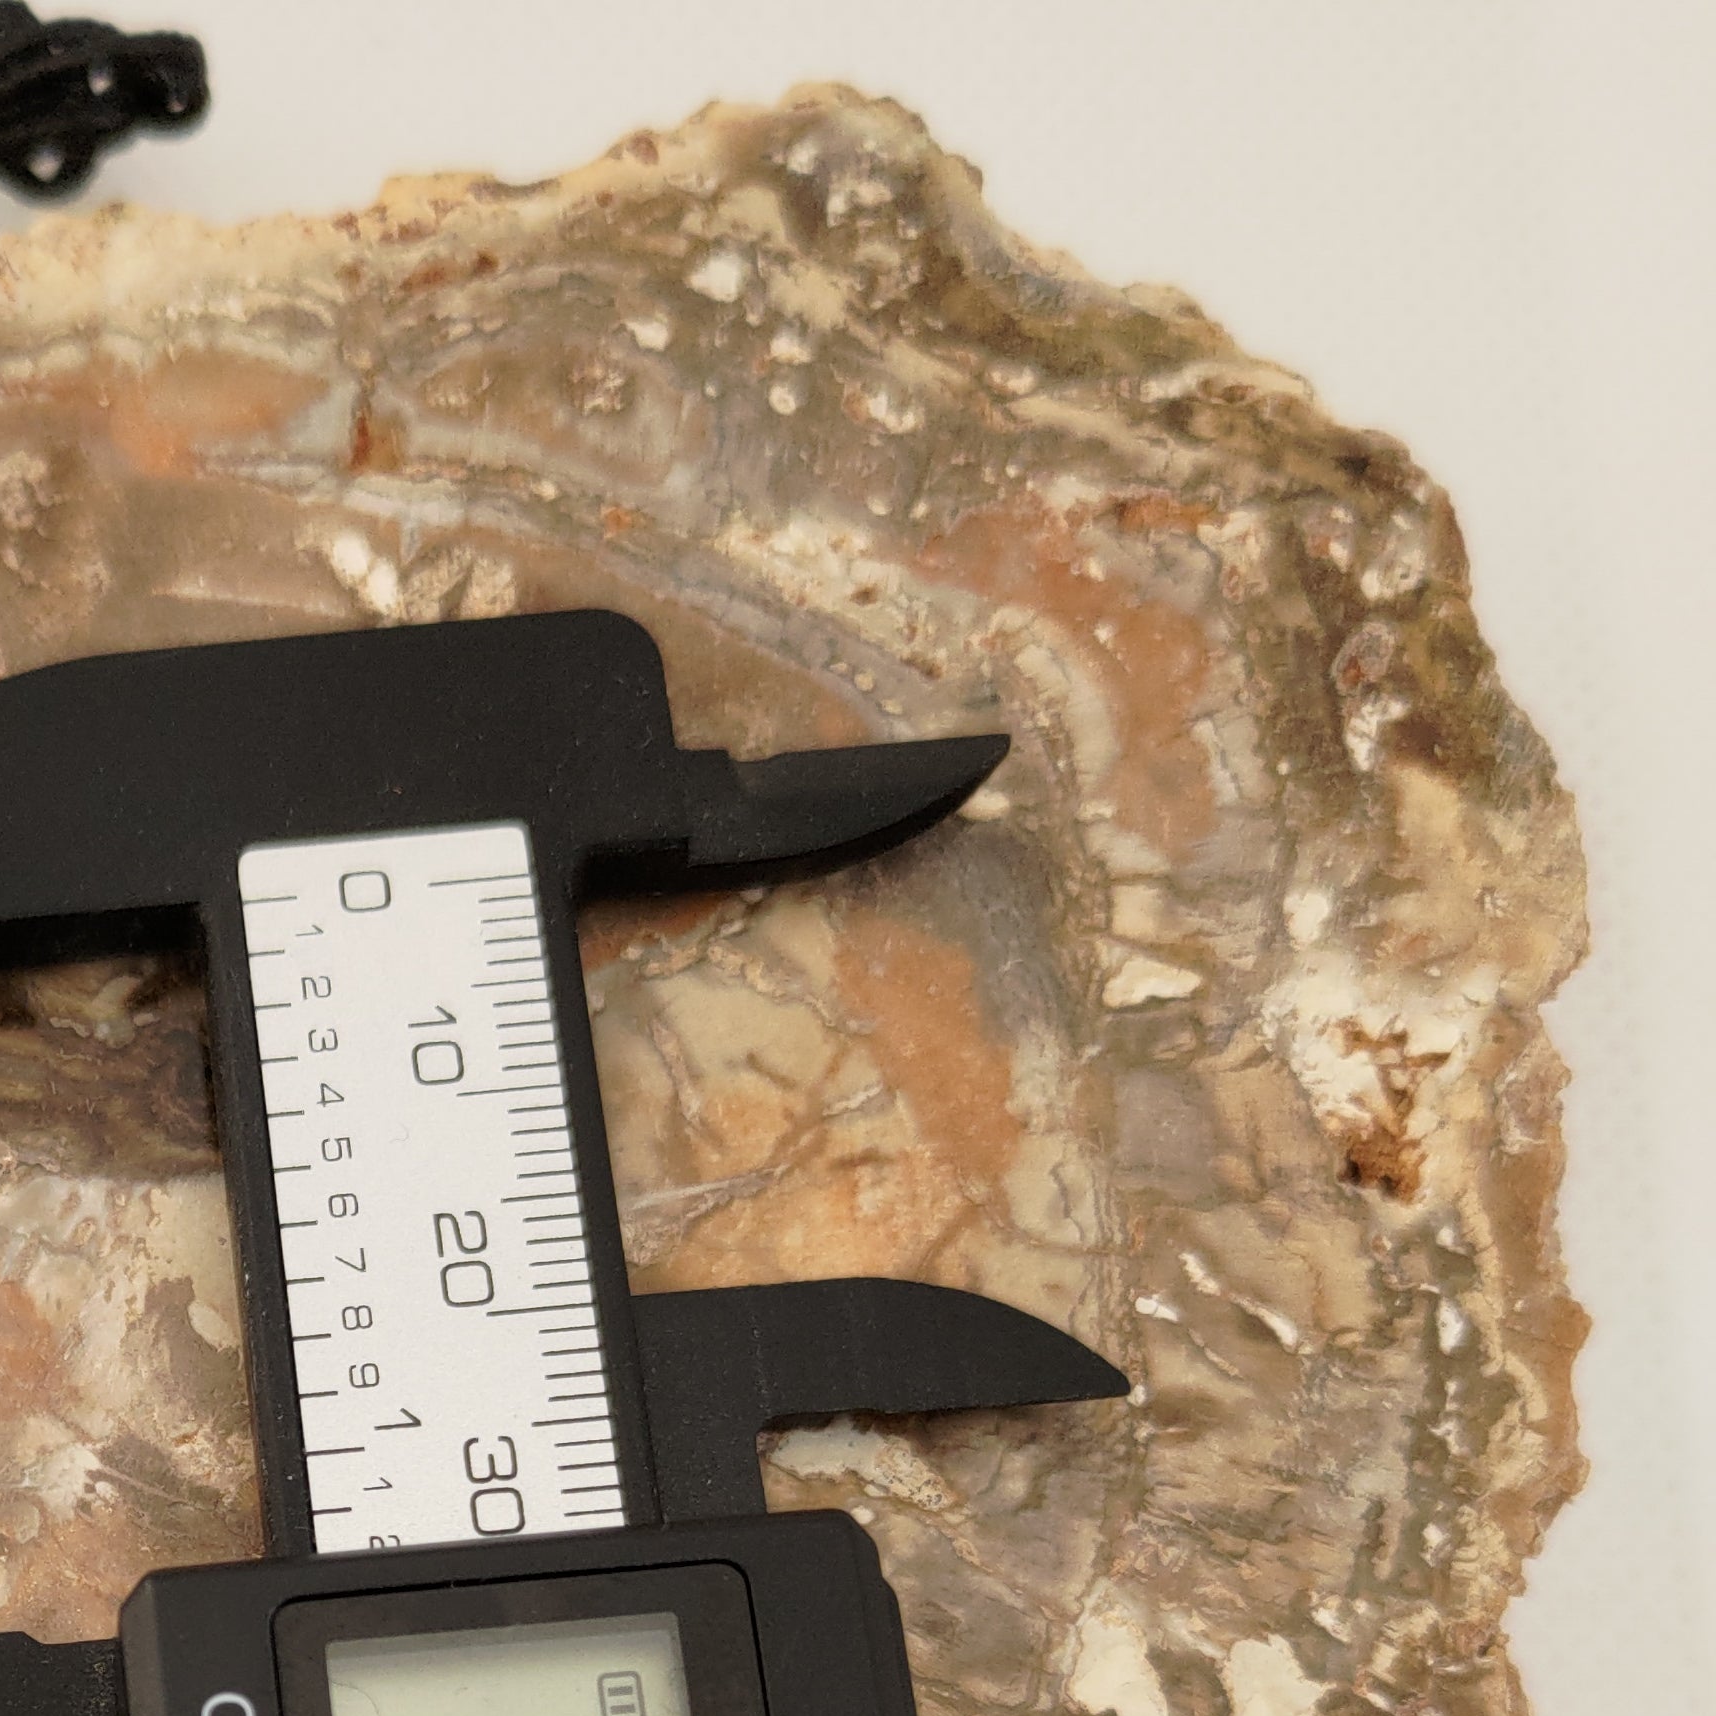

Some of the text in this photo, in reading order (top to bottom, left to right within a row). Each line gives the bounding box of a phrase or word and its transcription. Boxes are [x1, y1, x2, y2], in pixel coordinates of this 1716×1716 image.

[295, 923, 324, 938] 1
[300, 974, 332, 1000] 2
[307, 1027, 339, 1053] 3
[315, 1081, 345, 1109] 4
[321, 1136, 353, 1162] 5
[328, 1192, 359, 1218] 6
[338, 870, 526, 1536] 0 10 20 30
[335, 1246, 367, 1273] 7
[341, 1304, 374, 1331] 8
[348, 1362, 380, 1389] 9
[373, 1406, 422, 1431] 1
[363, 1476, 393, 1492] 1
